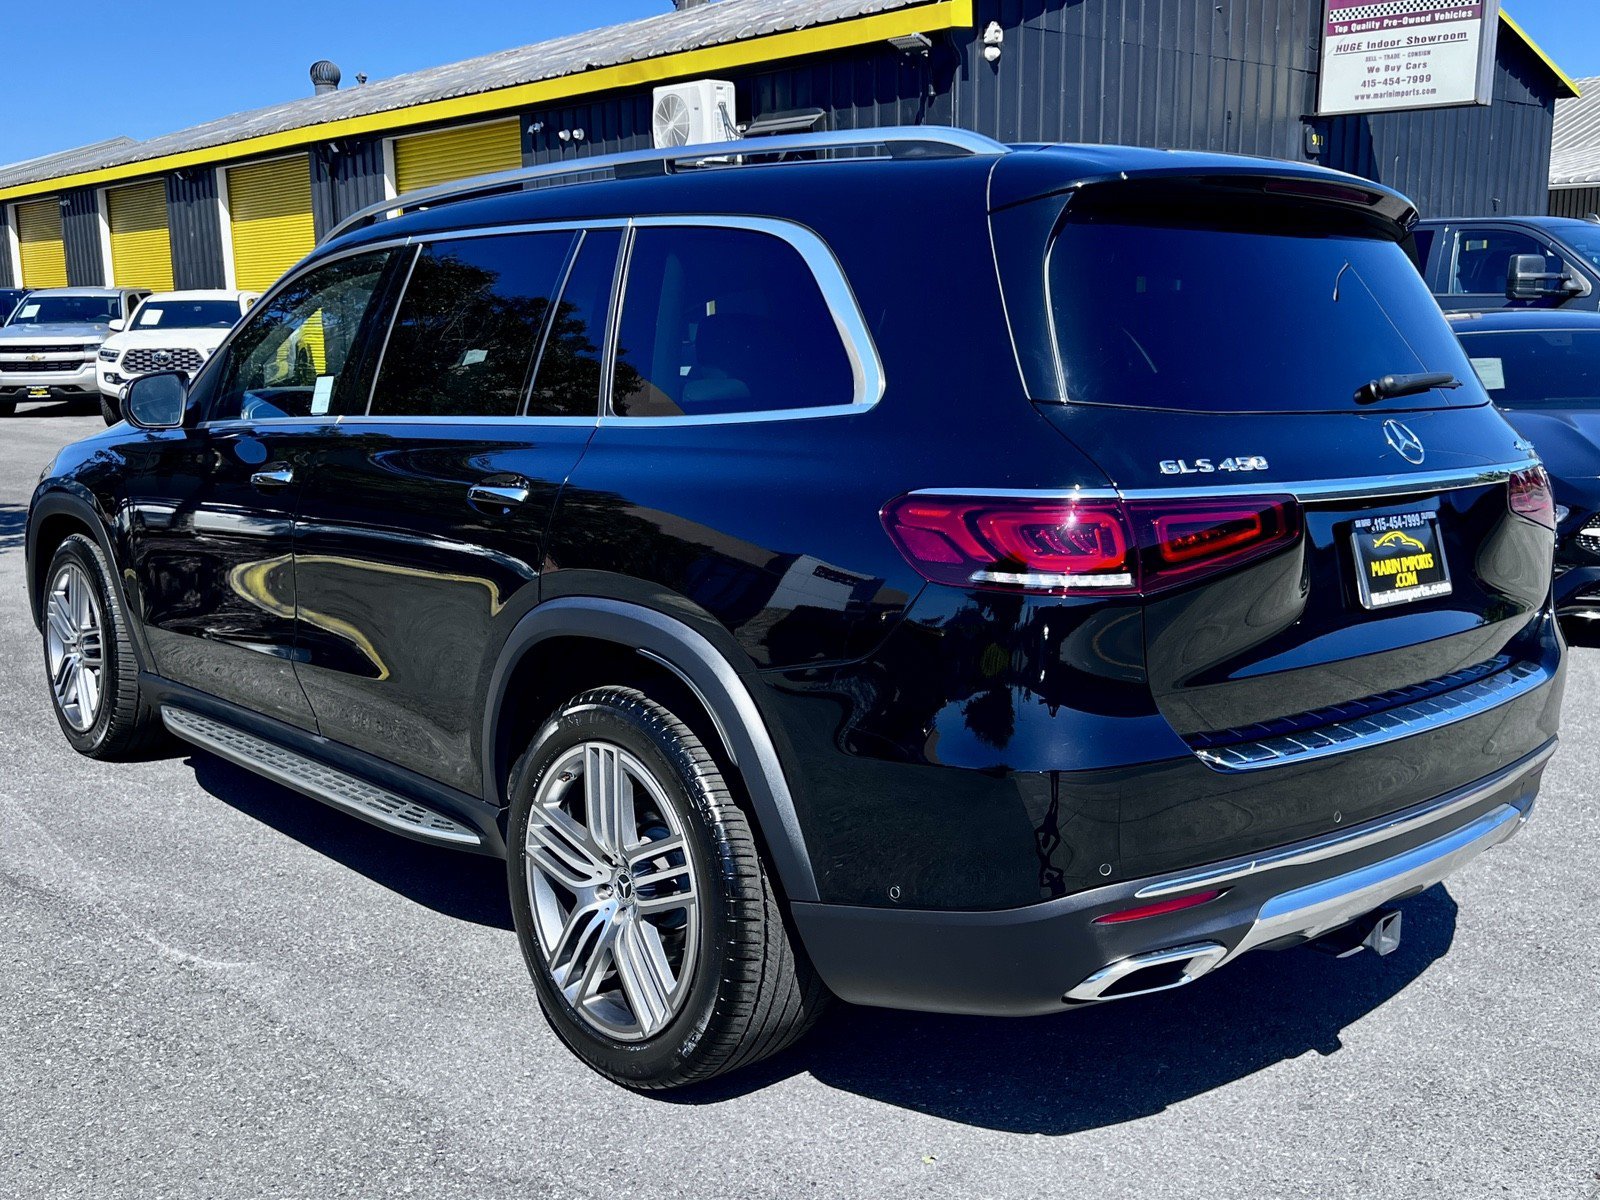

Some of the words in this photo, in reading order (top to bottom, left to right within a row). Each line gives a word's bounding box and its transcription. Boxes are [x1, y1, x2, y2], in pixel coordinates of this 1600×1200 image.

[1334, 25, 1348, 34] Top
[1351, 21, 1380, 33] Quality
[1383, 14, 1431, 28] Pre-Owned
[1434, 9, 1473, 21] Vehicles
[1335, 42, 1362, 53] HUGE
[1366, 38, 1401, 49] Indoor
[1406, 31, 1467, 45] Showroom
[1407, 50, 1431, 58] CONSIGN
[1366, 66, 1380, 74] We
[1384, 64, 1401, 72] Buy
[1405, 62, 1427, 70] Cars
[1360, 73, 1432, 88] 415-454-7999
[1354, 87, 1437, 101] www.marinimports.com
[1159, 458, 1215, 475] GLS
[1218, 456, 1269, 472] 450
[1370, 557, 1400, 577] MARIN
[1400, 552, 1434, 573] IMPORTS
[1395, 570, 1418, 588] .COM
